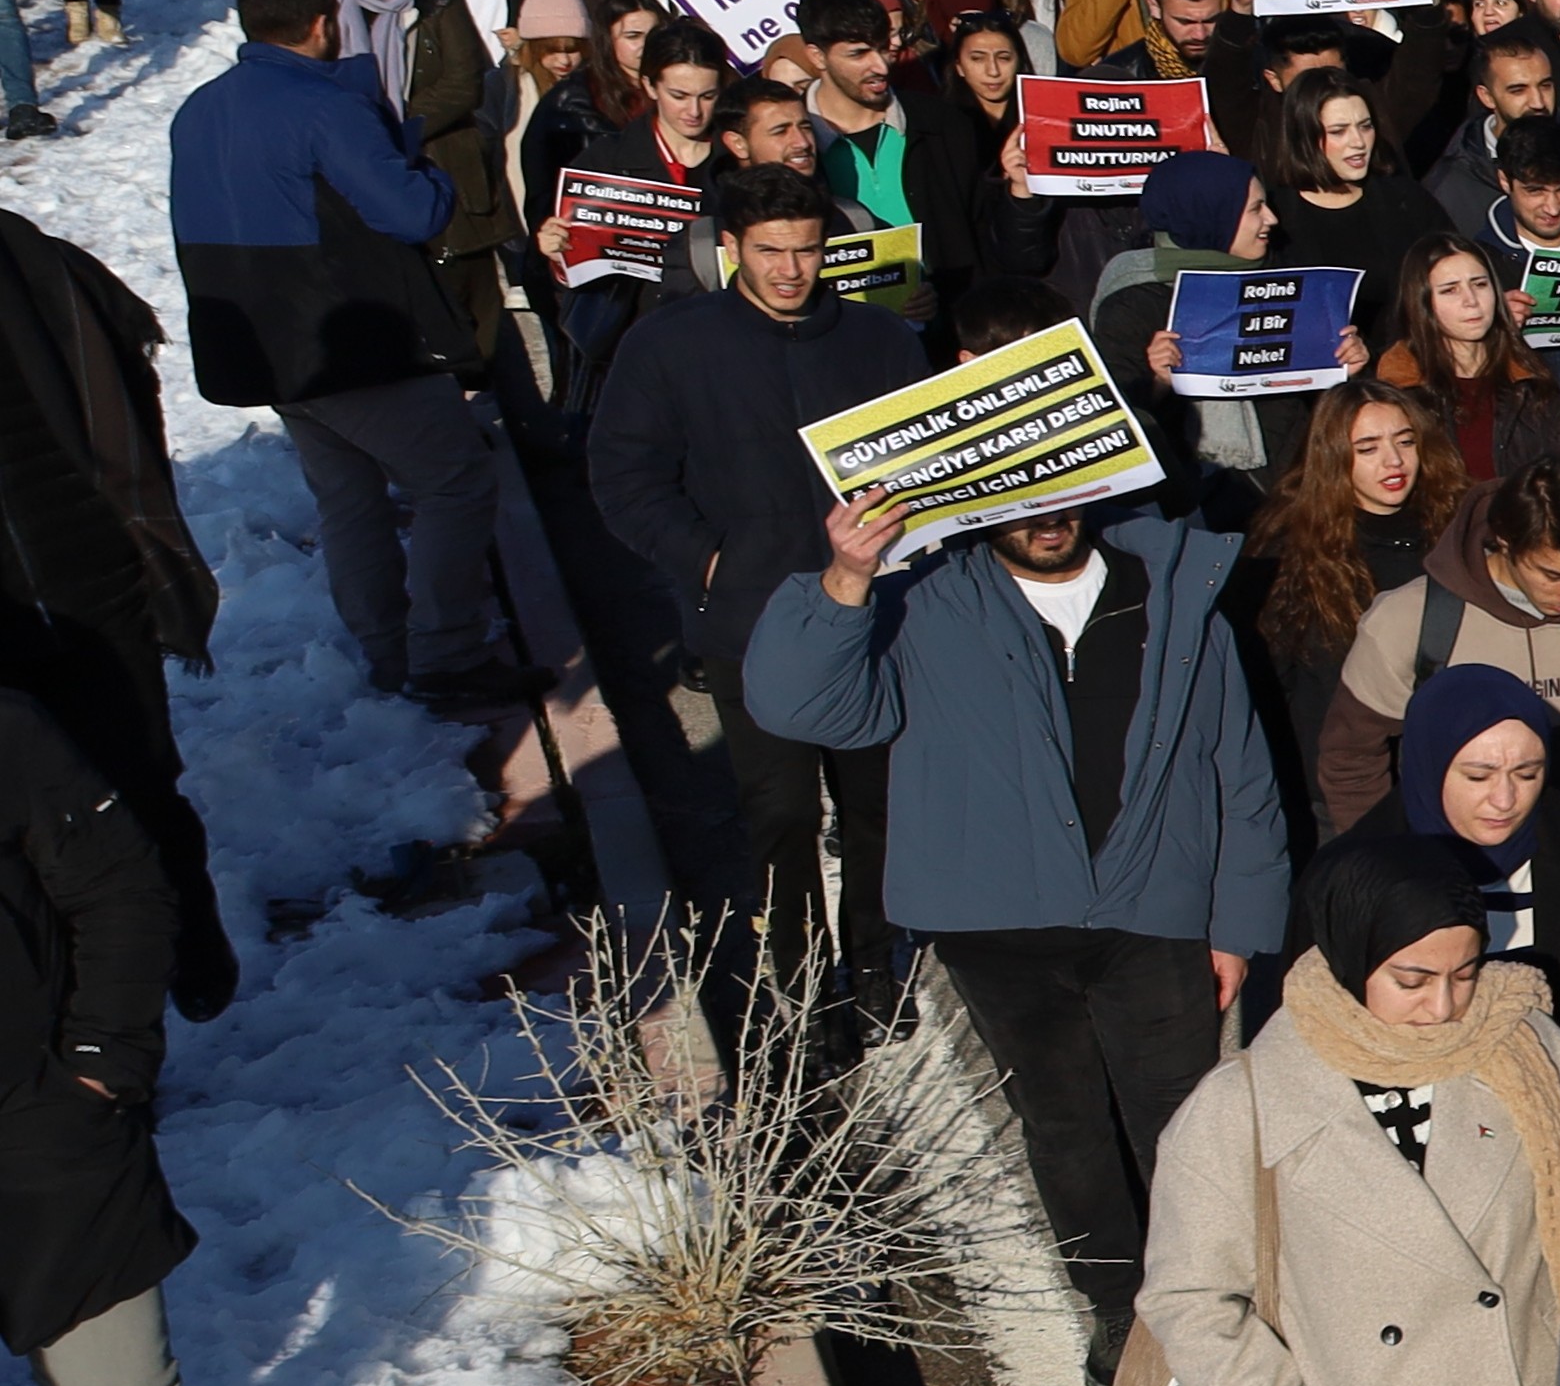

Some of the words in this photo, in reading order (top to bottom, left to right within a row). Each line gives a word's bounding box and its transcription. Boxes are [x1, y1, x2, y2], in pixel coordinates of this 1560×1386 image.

[740, 16, 783, 51] ne
[1076, 123, 1157, 137] UNUTMA
[568, 182, 582, 194] Ji
[656, 195, 693, 210] Heta
[575, 208, 602, 222] Em
[617, 215, 665, 231] Hesab
[837, 270, 900, 292] Dadbar
[1245, 317, 1261, 332] Ji
[1239, 348, 1285, 365] Neke!
[838, 410, 957, 470] GÜVENLİK
[956, 355, 1085, 422] ÖNLEMLERİ
[980, 421, 1048, 460] KARŞI
[1043, 391, 1114, 429] DEĞİL
[1033, 429, 1130, 479] ALINSIN!
